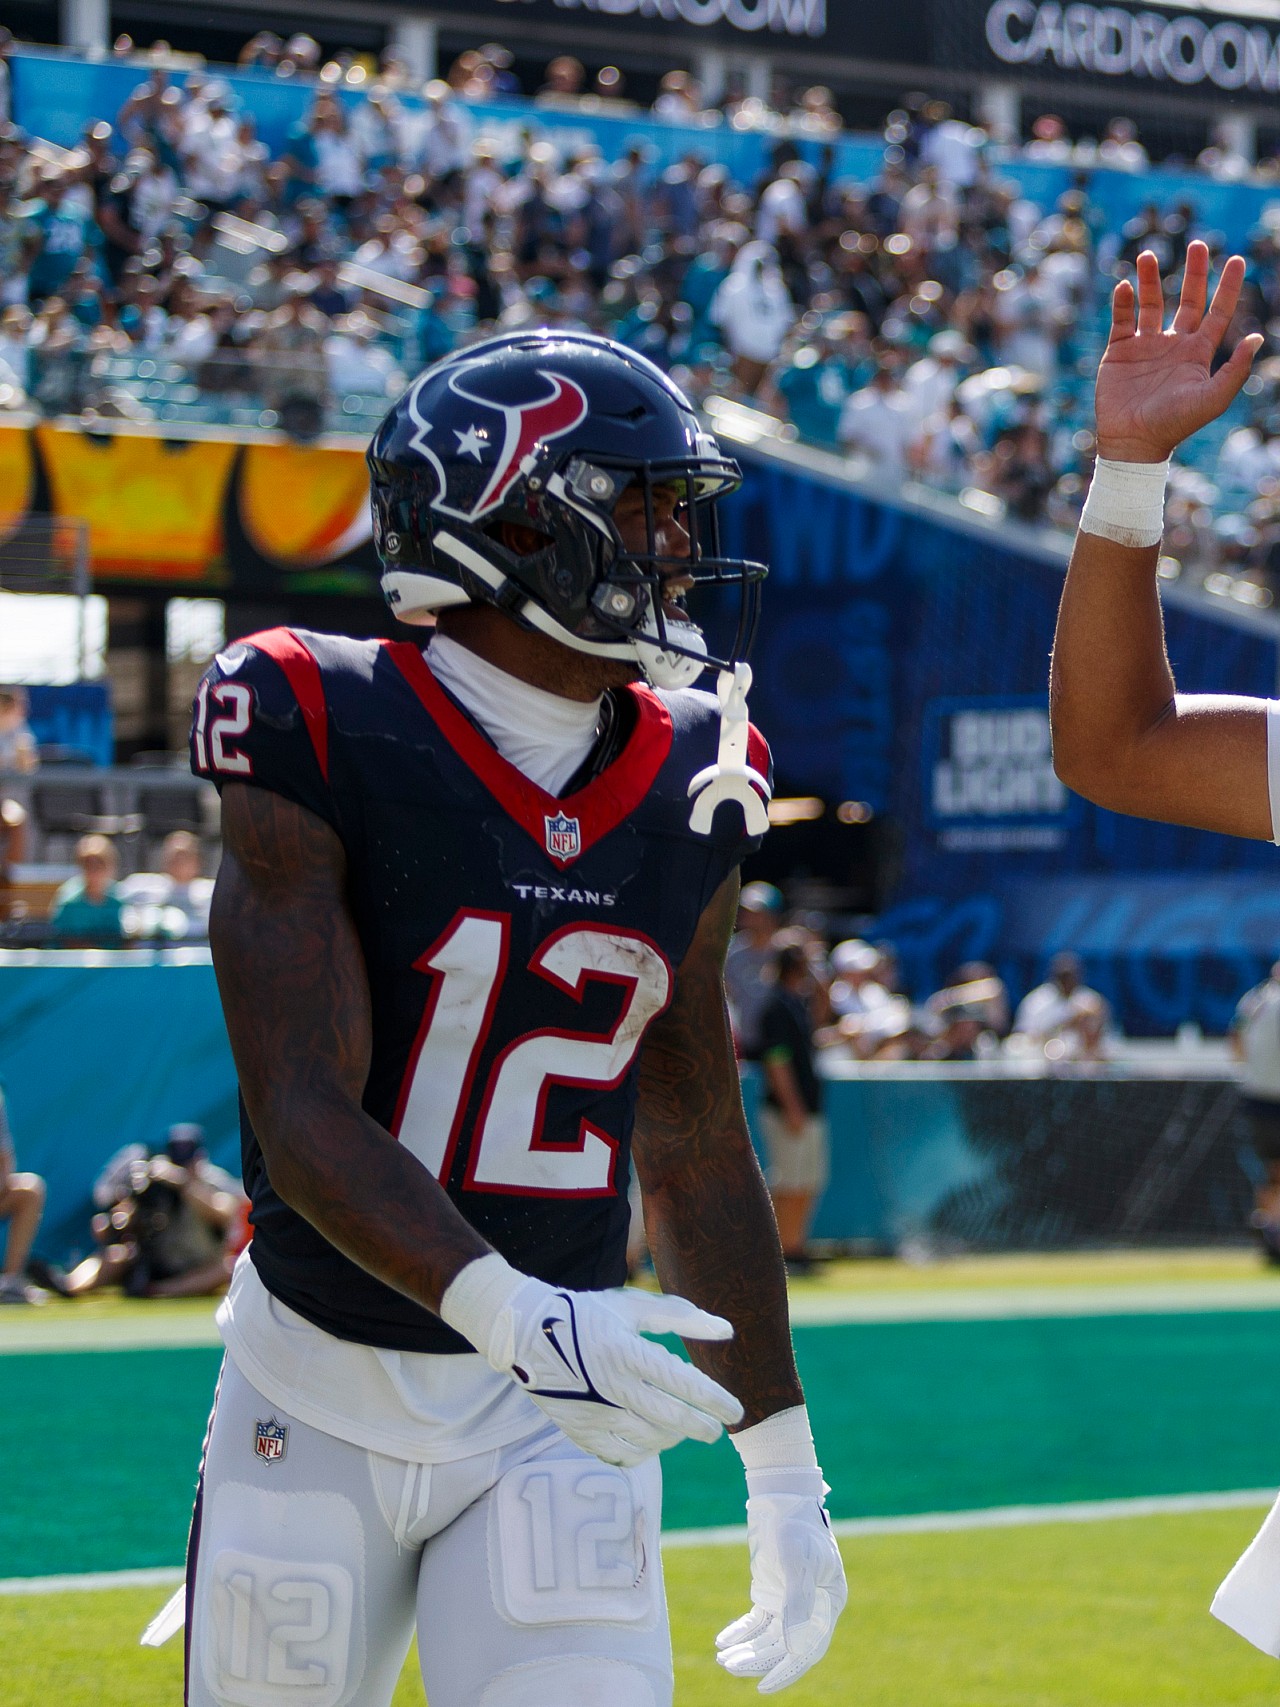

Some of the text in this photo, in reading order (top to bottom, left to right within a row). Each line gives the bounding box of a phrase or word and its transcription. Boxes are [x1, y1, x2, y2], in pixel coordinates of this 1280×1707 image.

[195, 678, 254, 776] 12
[952, 711, 1051, 765] BUD
[551, 833, 576, 851] NFL
[512, 884, 616, 906] TEXANS
[390, 906, 674, 1198] 12
[257, 1437, 281, 1457] NFL
[519, 1470, 636, 1592] 12
[224, 1572, 332, 1687] 12
